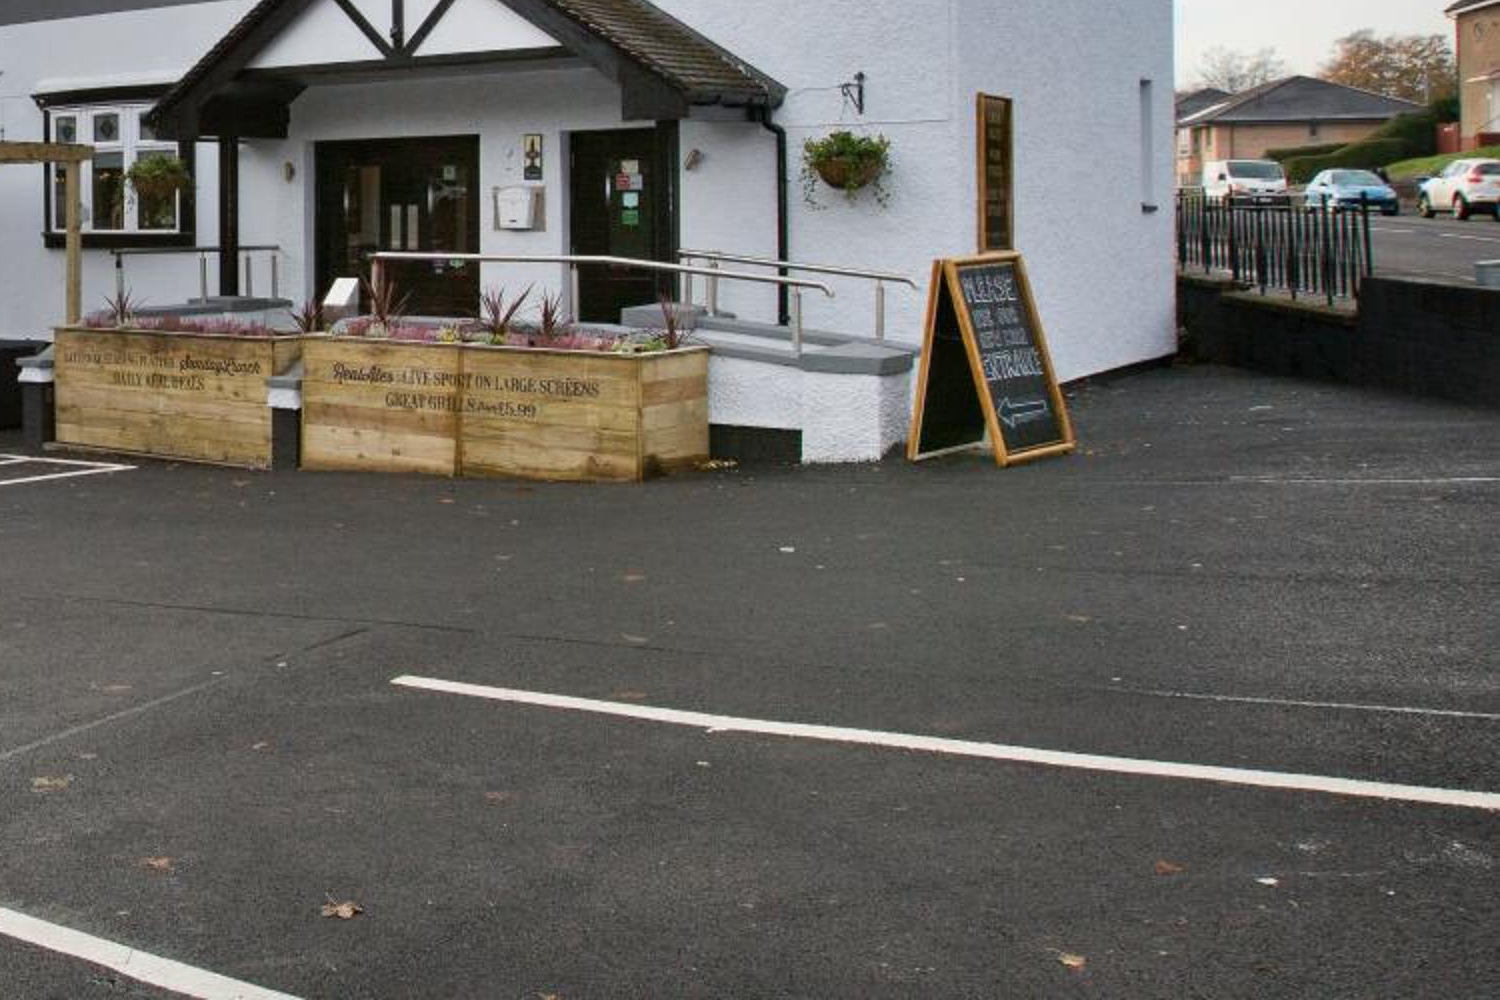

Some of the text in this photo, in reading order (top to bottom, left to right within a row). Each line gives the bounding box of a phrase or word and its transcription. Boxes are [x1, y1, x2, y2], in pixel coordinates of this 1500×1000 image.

[402, 369, 430, 385] LIVE
[433, 371, 473, 389] SPORT
[475, 375, 491, 389] ON
[495, 375, 537, 393] LARGE
[539, 377, 600, 398] SCREENS
[385, 392, 426, 409] GREAT
